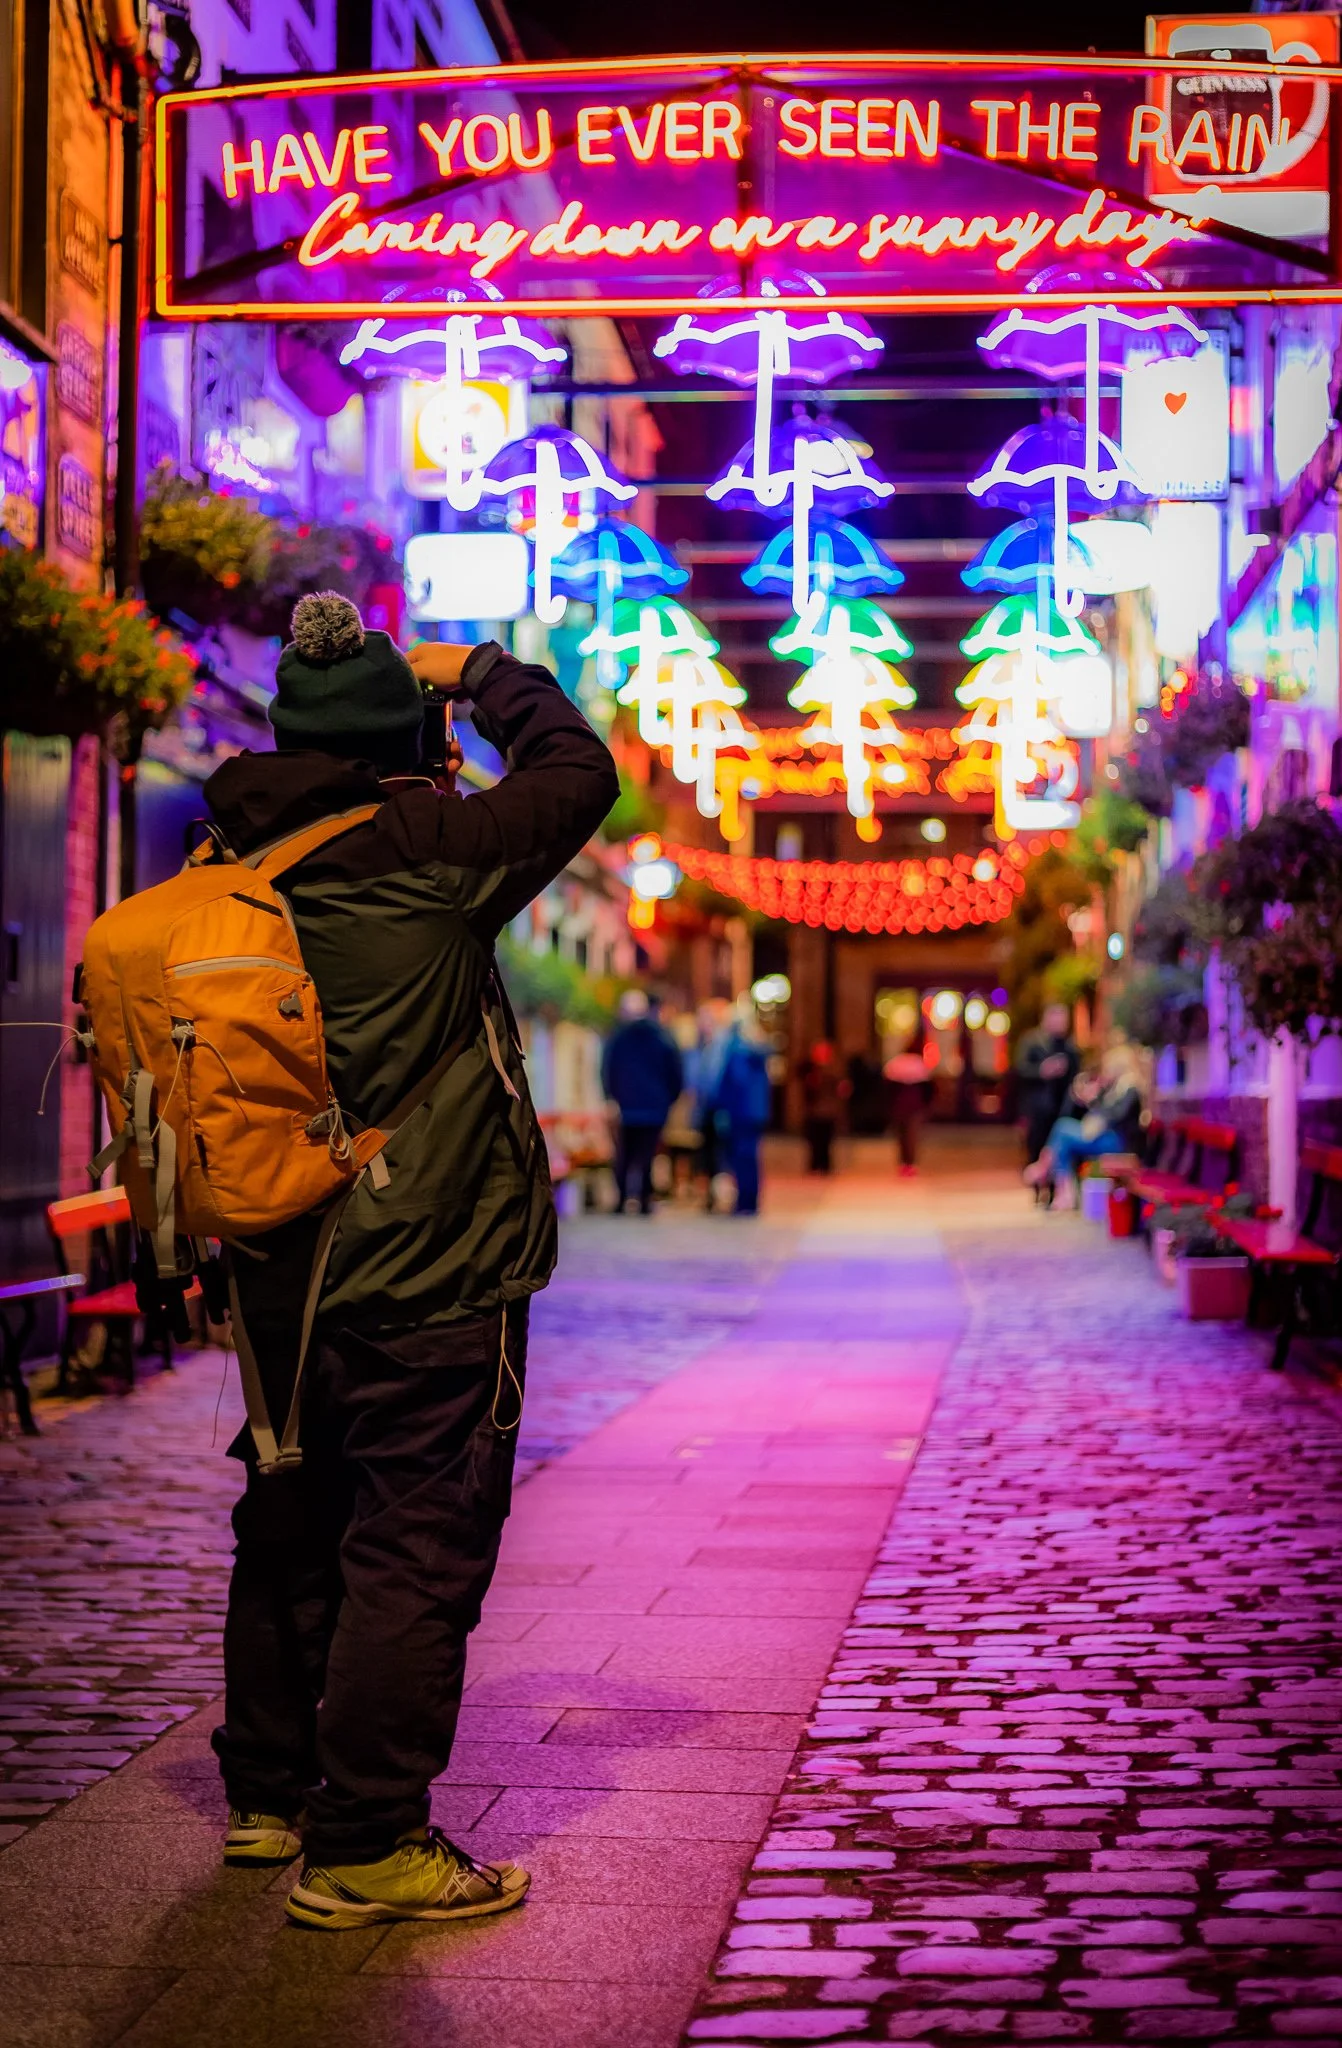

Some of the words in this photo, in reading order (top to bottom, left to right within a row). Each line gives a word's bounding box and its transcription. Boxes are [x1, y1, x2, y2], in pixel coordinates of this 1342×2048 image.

[222, 125, 393, 199] HAVE
[418, 107, 553, 177] YOU
[576, 100, 744, 164] EVER
[777, 98, 941, 158] SEEN
[970, 99, 1102, 162] THE
[1127, 104, 1292, 174] RAIN
[297, 191, 529, 279] Coming
[529, 200, 703, 257] down
[708, 215, 795, 252] on
[795, 215, 859, 248] a
[857, 213, 1056, 272] sunny
